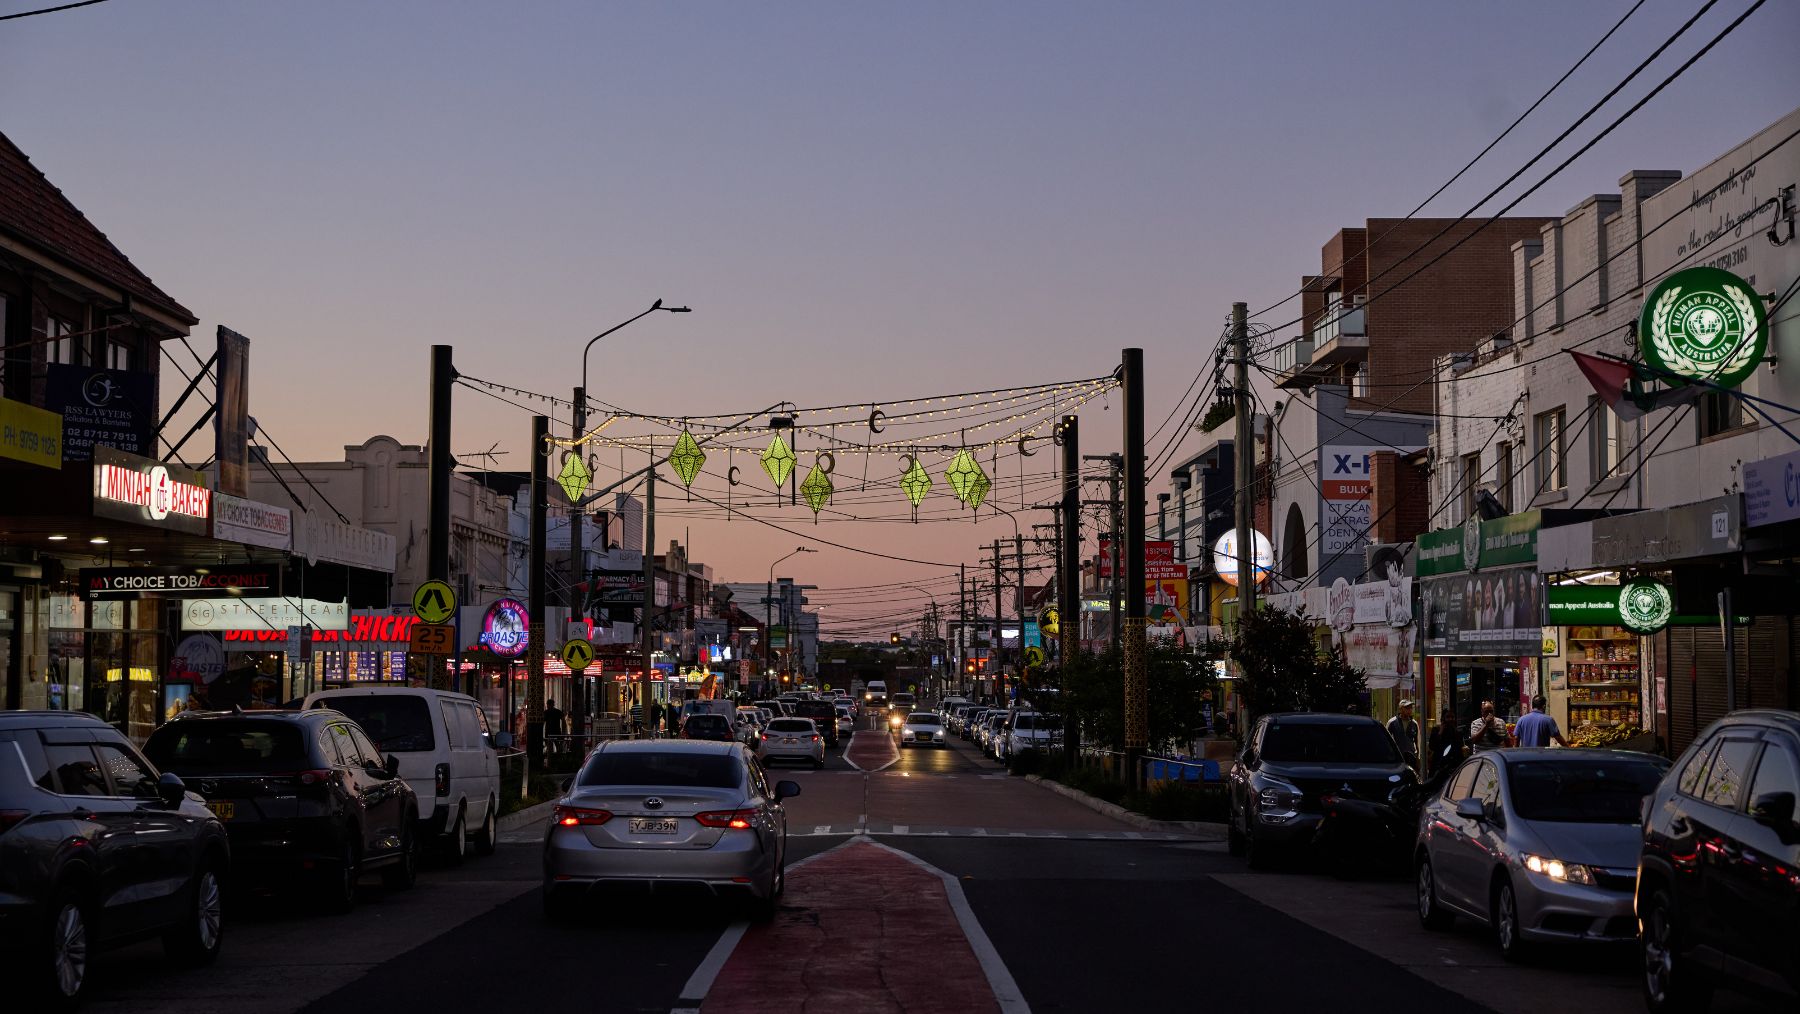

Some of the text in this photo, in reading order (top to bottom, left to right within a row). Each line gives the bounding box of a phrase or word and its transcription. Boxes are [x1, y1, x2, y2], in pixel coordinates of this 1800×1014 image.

[1740, 166, 1756, 195] you
[1678, 245, 1687, 256] on
[1688, 229, 1702, 251] the
[1703, 215, 1722, 244] road
[1732, 245, 1748, 267] 3161
[1672, 296, 1737, 327] HUMAN APPEAL
[1679, 341, 1733, 361] AUSTRALIA
[65, 405, 132, 419] RSS LAWYERS
[67, 428, 137, 441] 02 8712 7913
[120, 443, 138, 451] 138
[1339, 485, 1368, 495] BULK
[172, 480, 211, 519] BAKERY
[1328, 503, 1341, 513] CT
[227, 504, 249, 525] CHOICE
[250, 507, 289, 533] TOBACCONIST
[1714, 517, 1727, 533] 121
[1328, 540, 1357, 551] JOINT
[89, 573, 269, 589] MY CHOICE TOBACCONIST
[1565, 602, 1587, 610] Appeal
[1588, 601, 1615, 609] Australia
[419, 627, 447, 644] 25
[479, 631, 529, 644] BROASTE
[493, 643, 524, 655] CHICKEN
